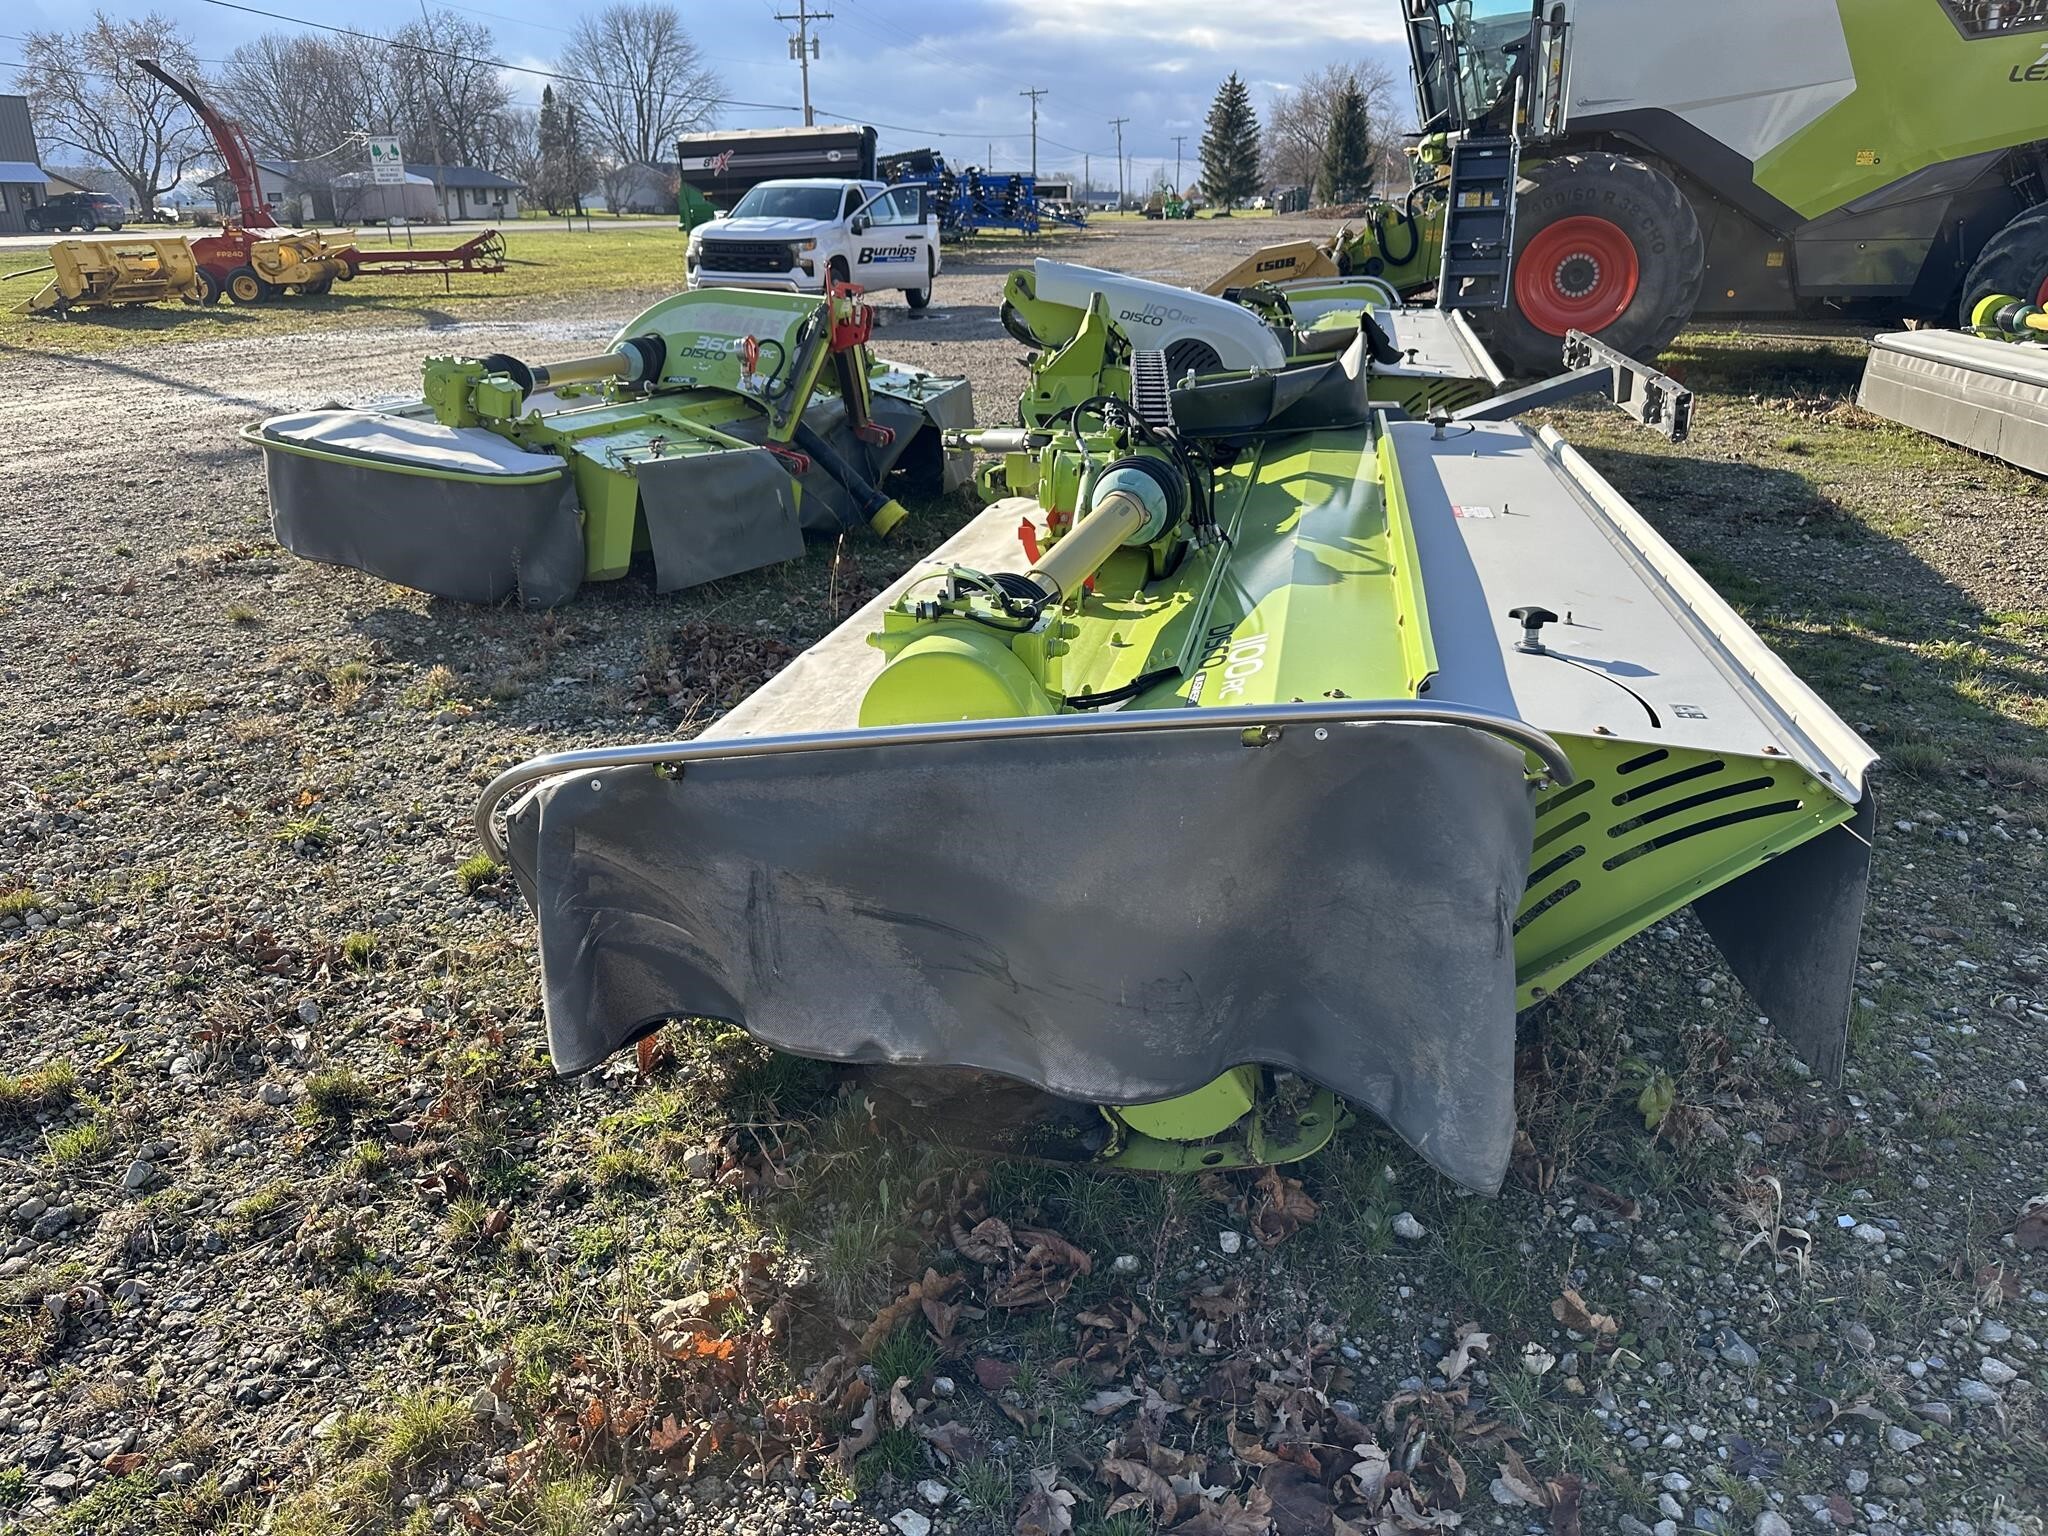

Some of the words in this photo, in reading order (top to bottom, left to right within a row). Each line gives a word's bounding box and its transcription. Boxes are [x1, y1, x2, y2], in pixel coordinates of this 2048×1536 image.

[2008, 64, 2048, 82] LE
[857, 244, 917, 265] Burnips
[1119, 310, 1164, 327] DISCO
[680, 347, 727, 361] DISCO
[1198, 622, 1236, 669] DISCO
